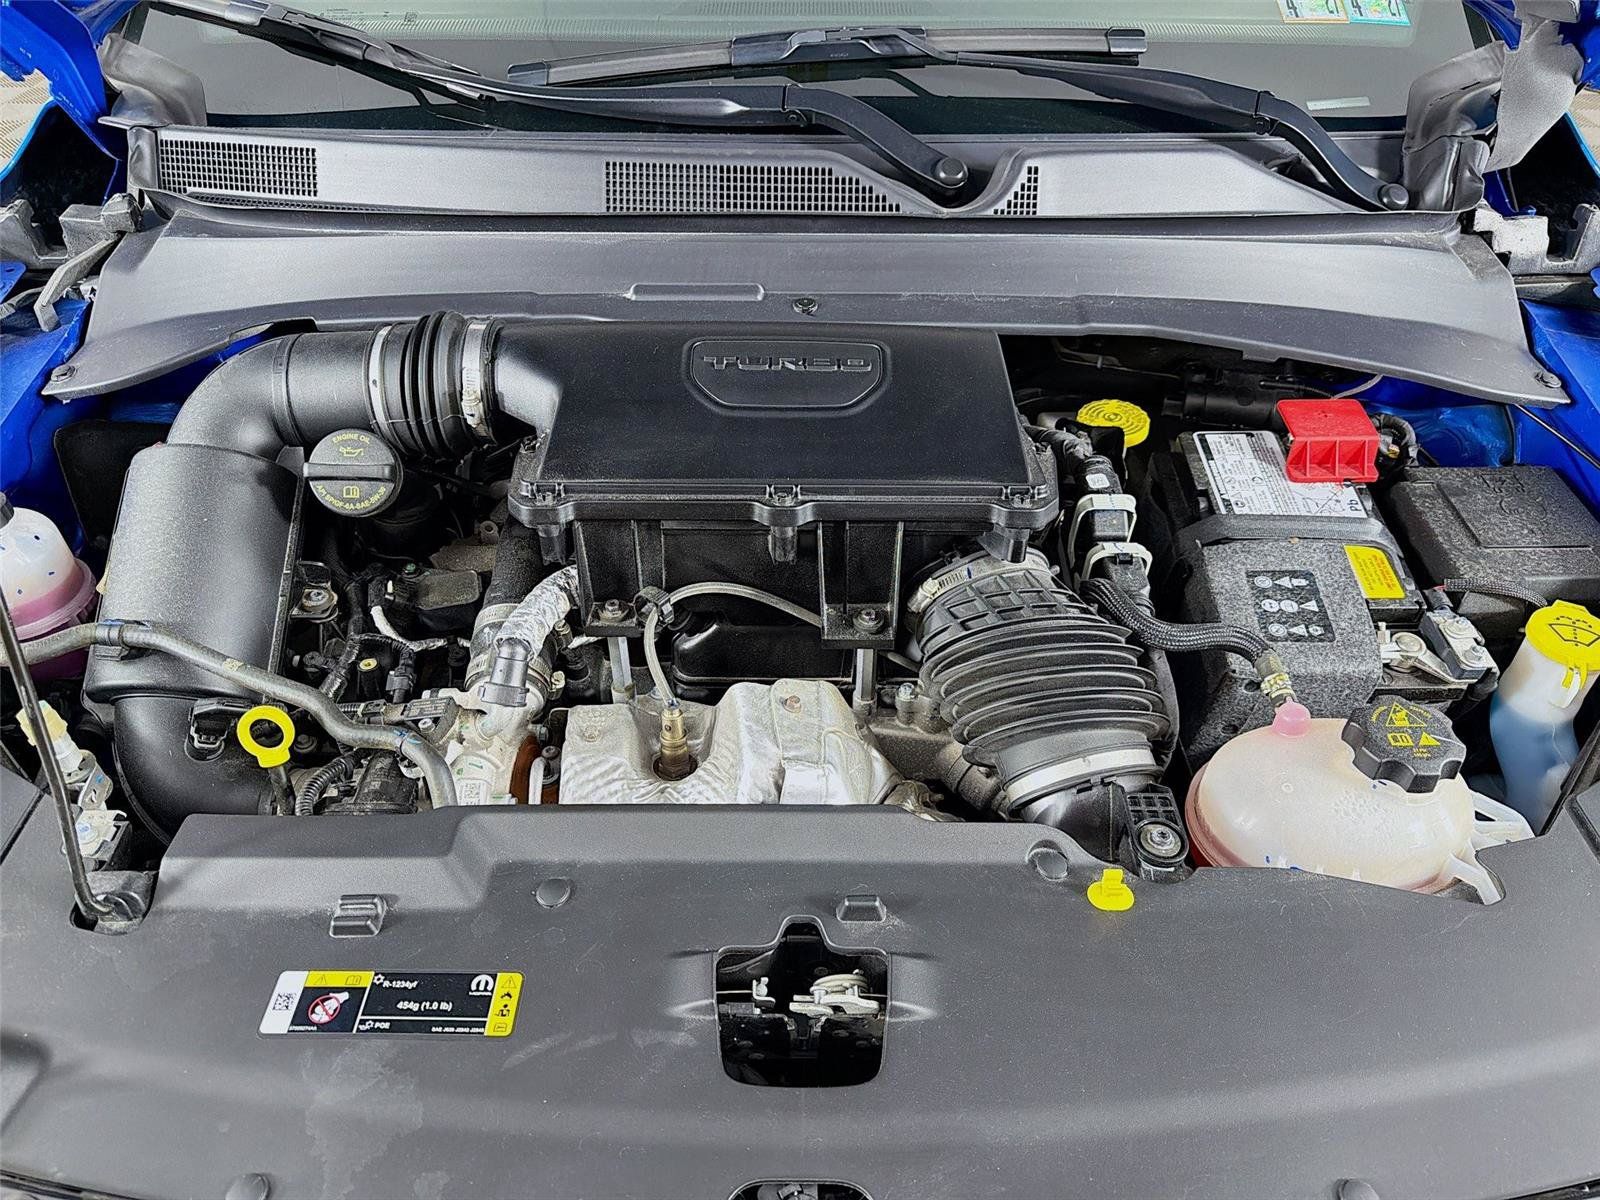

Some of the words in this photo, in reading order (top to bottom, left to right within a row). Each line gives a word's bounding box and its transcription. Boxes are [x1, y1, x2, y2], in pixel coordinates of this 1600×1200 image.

[703, 356, 873, 372] TURBO
[332, 433, 359, 443] ENGINE
[359, 434, 370, 445] OIL
[382, 980, 419, 990] R-1234yf
[396, 1001, 420, 1012] 454g
[420, 1001, 439, 1012] (1.0
